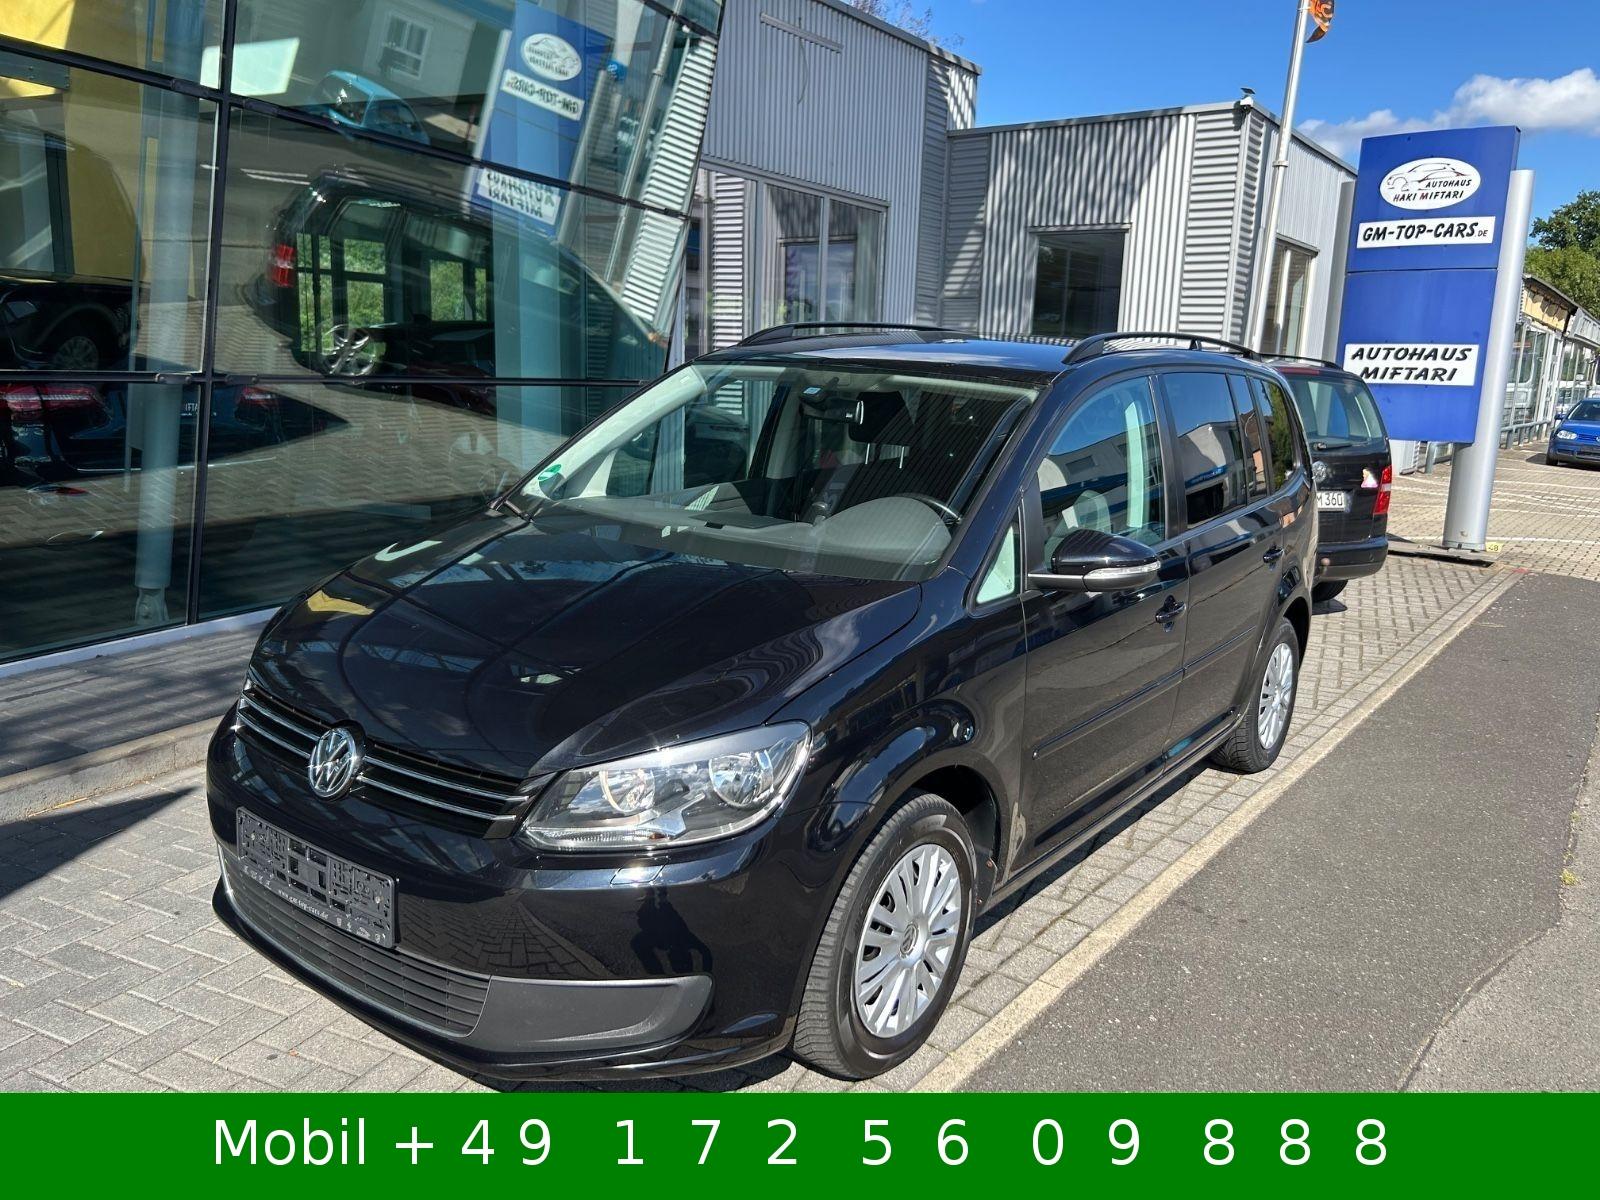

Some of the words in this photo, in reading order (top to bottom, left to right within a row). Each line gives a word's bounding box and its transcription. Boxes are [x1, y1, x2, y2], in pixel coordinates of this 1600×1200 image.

[1425, 179, 1472, 188] AUTOHAUS
[1392, 192, 1417, 202] HAKI
[1419, 190, 1465, 200] MIFTARI
[1351, 347, 1472, 361] AUTOHAUS
[1360, 366, 1458, 382] MIFTARI
